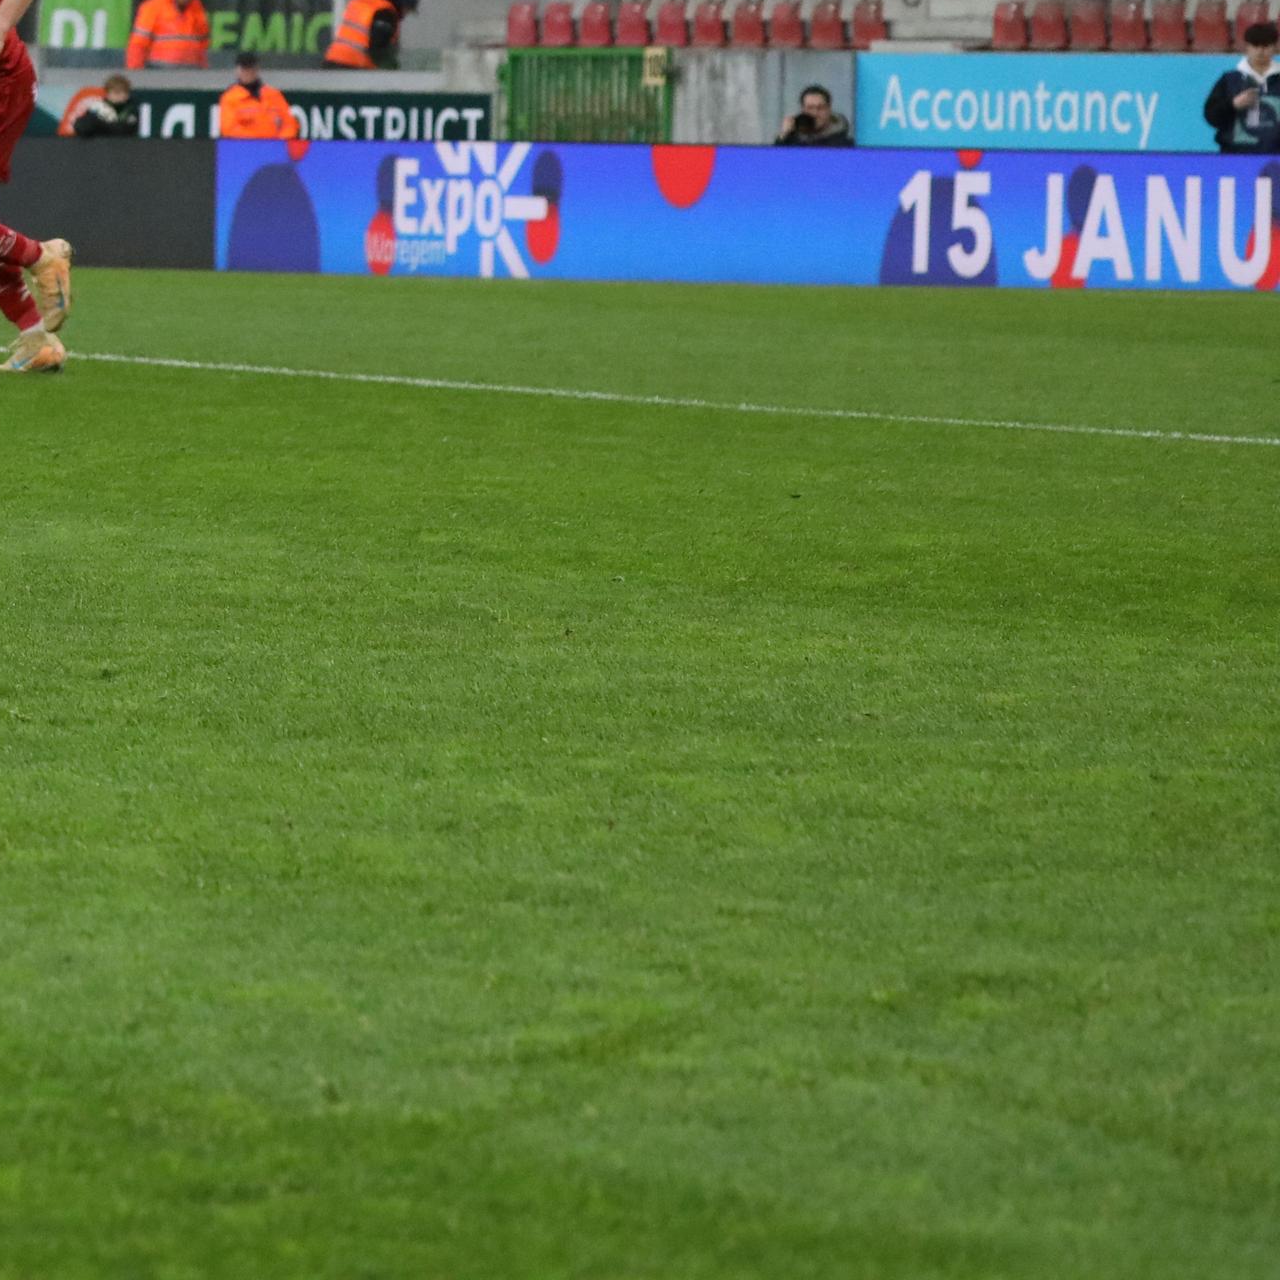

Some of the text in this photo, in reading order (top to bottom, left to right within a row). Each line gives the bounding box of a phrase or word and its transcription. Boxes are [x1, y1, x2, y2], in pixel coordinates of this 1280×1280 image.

[880, 74, 1160, 150] Accountancy
[393, 157, 504, 255] Expo
[898, 169, 1273, 287] 15 JANU
